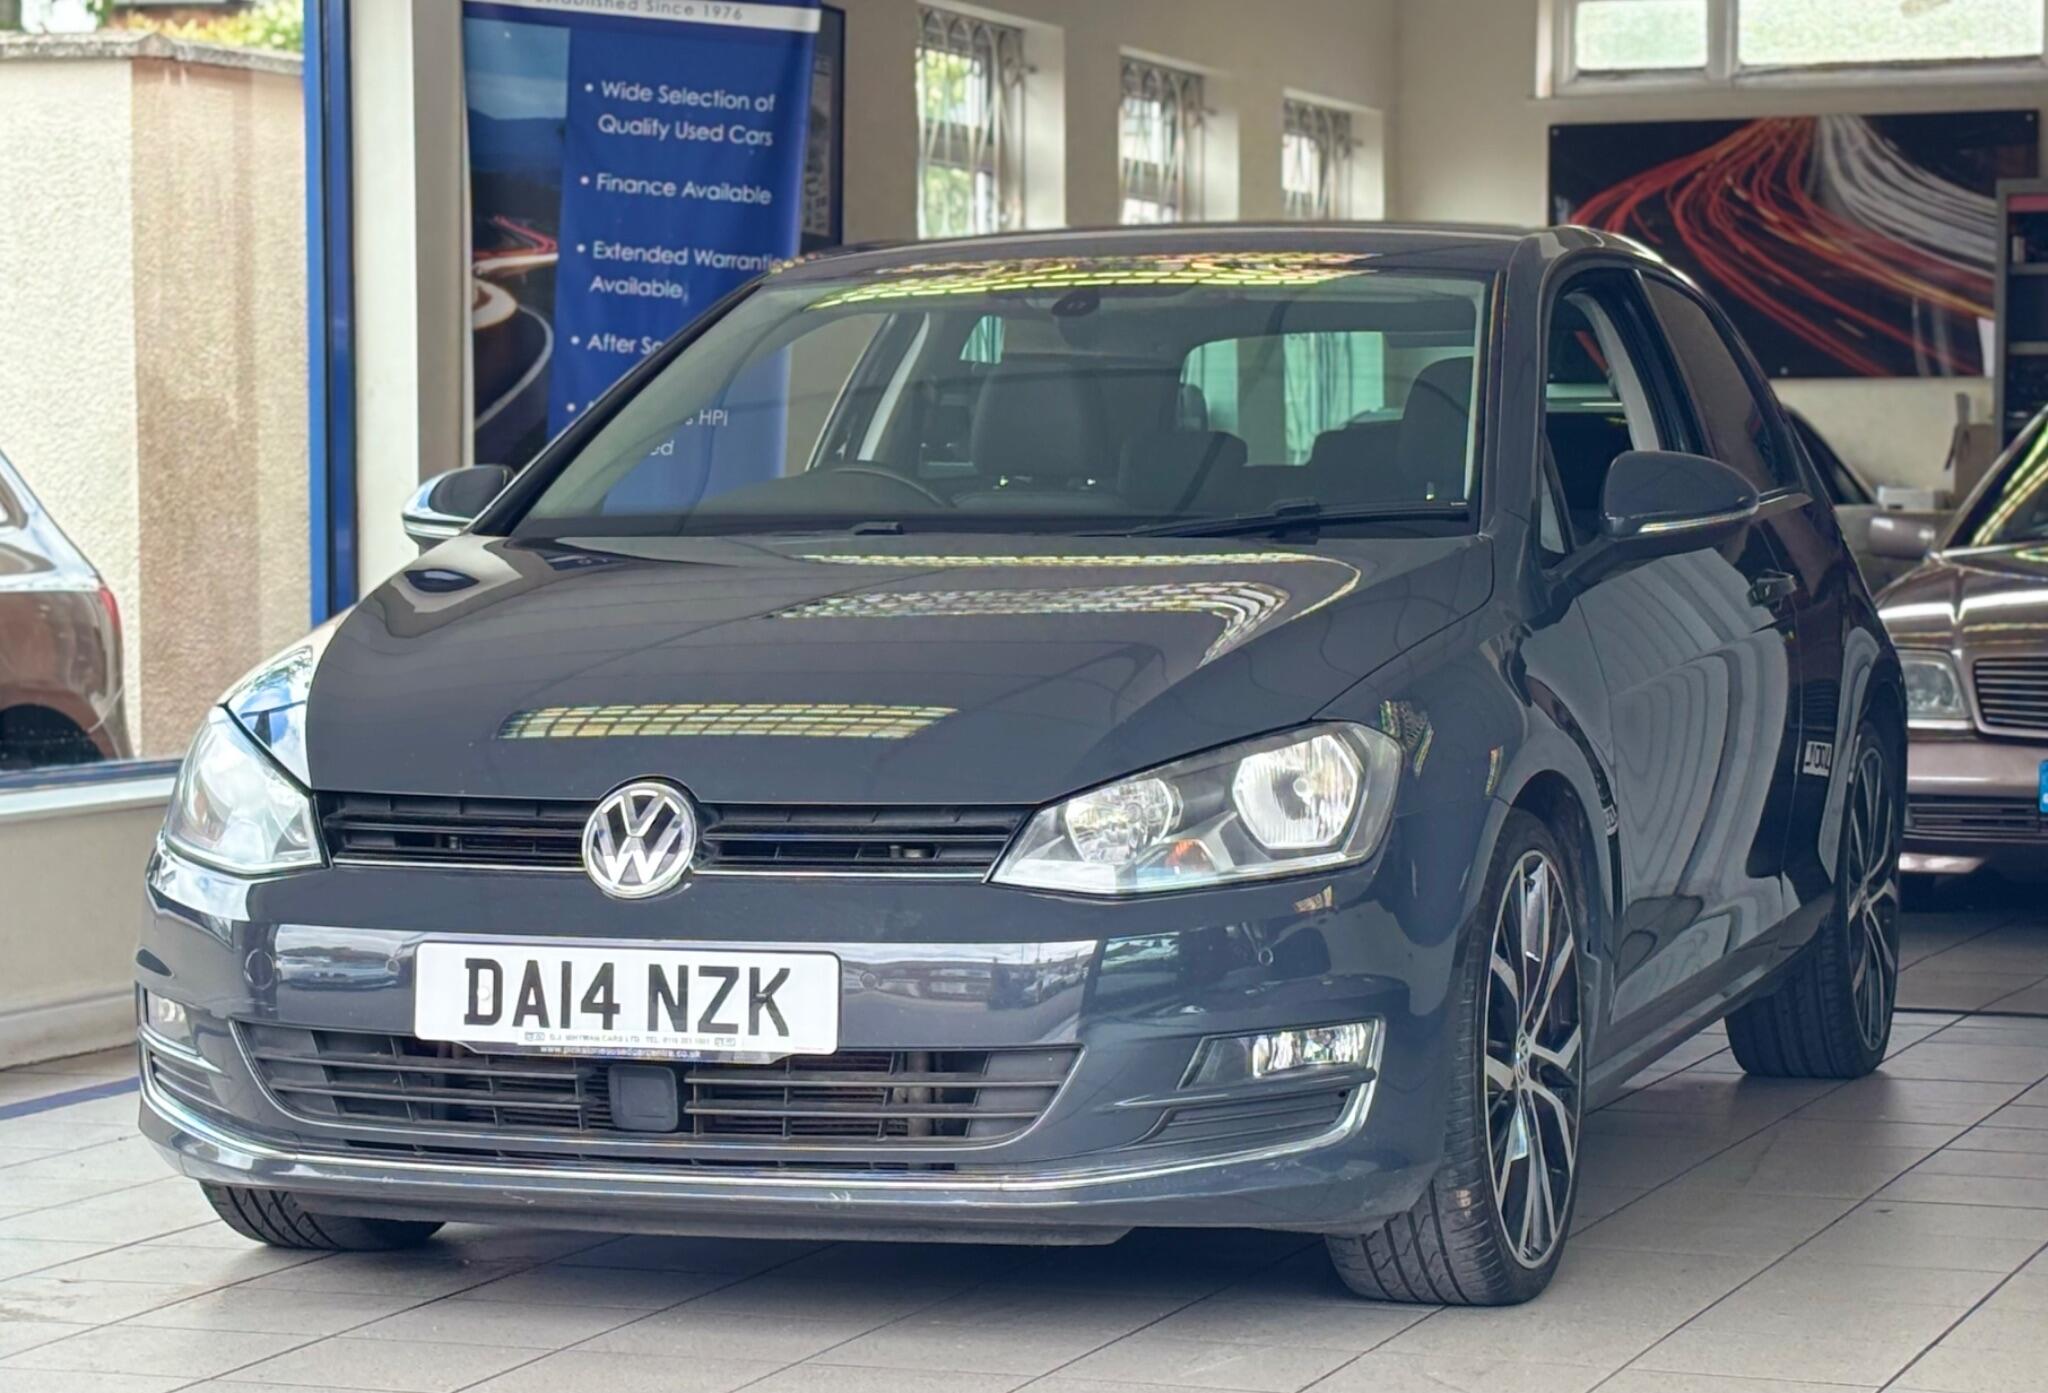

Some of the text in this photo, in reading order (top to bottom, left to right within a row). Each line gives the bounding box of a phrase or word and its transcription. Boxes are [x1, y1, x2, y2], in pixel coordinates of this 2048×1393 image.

[646, 0, 695, 17] Since
[703, 3, 743, 20] 1976
[601, 79, 775, 113] Wide Selection of
[598, 114, 774, 147] Quality Used Cars
[596, 172, 773, 206] Finance Available
[592, 240, 688, 267] Extended
[586, 333, 638, 354] After
[698, 408, 729, 427] HPI
[463, 956, 791, 1037] DA14 NZK
